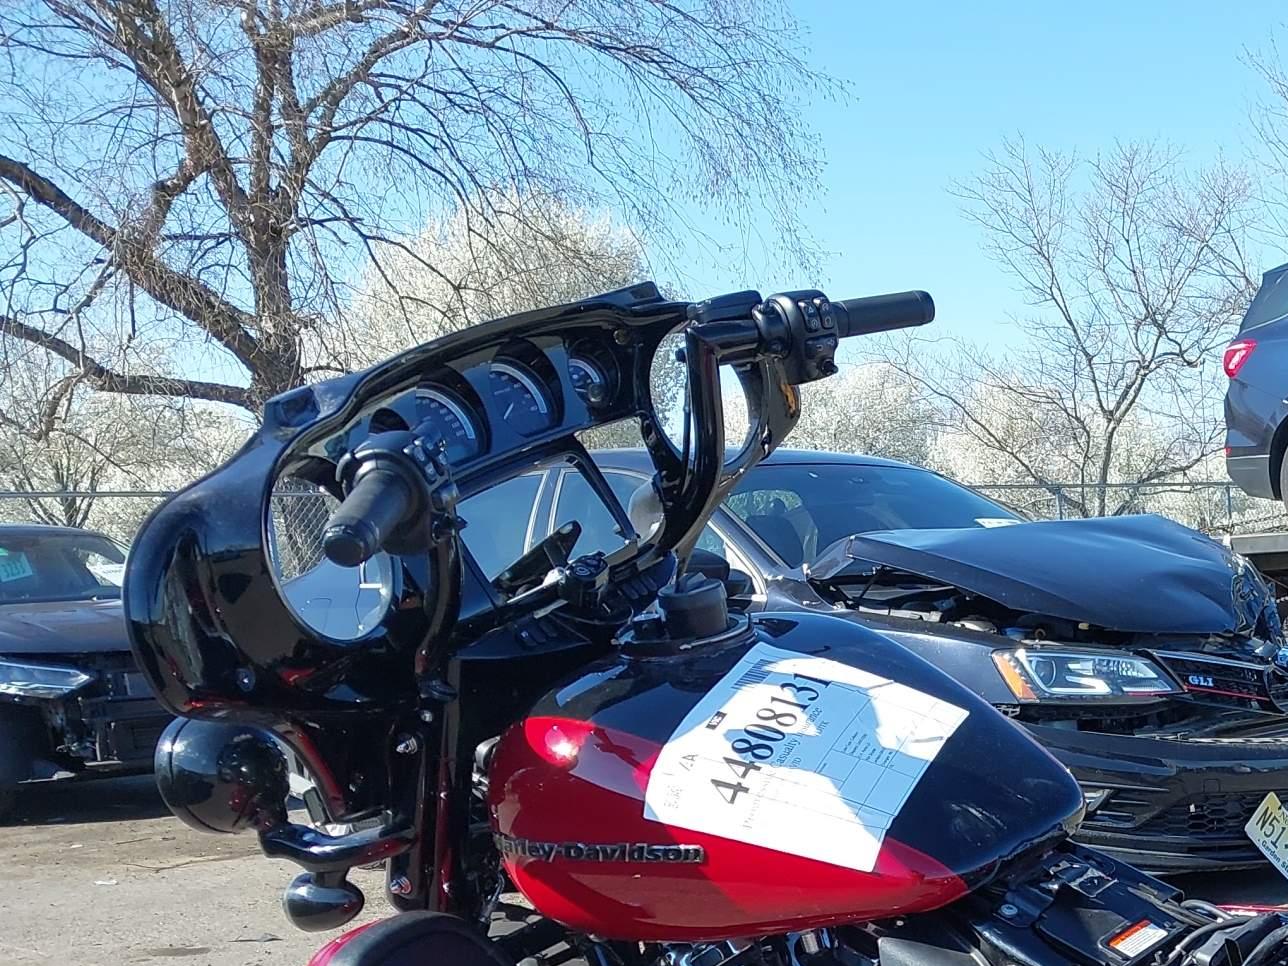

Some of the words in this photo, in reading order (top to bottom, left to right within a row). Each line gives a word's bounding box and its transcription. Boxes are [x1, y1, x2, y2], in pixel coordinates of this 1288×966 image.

[1188, 675, 1214, 687] GLI
[710, 673, 832, 804] 44808131
[1255, 806, 1286, 850] N51
[1261, 840, 1281, 863] Garden
